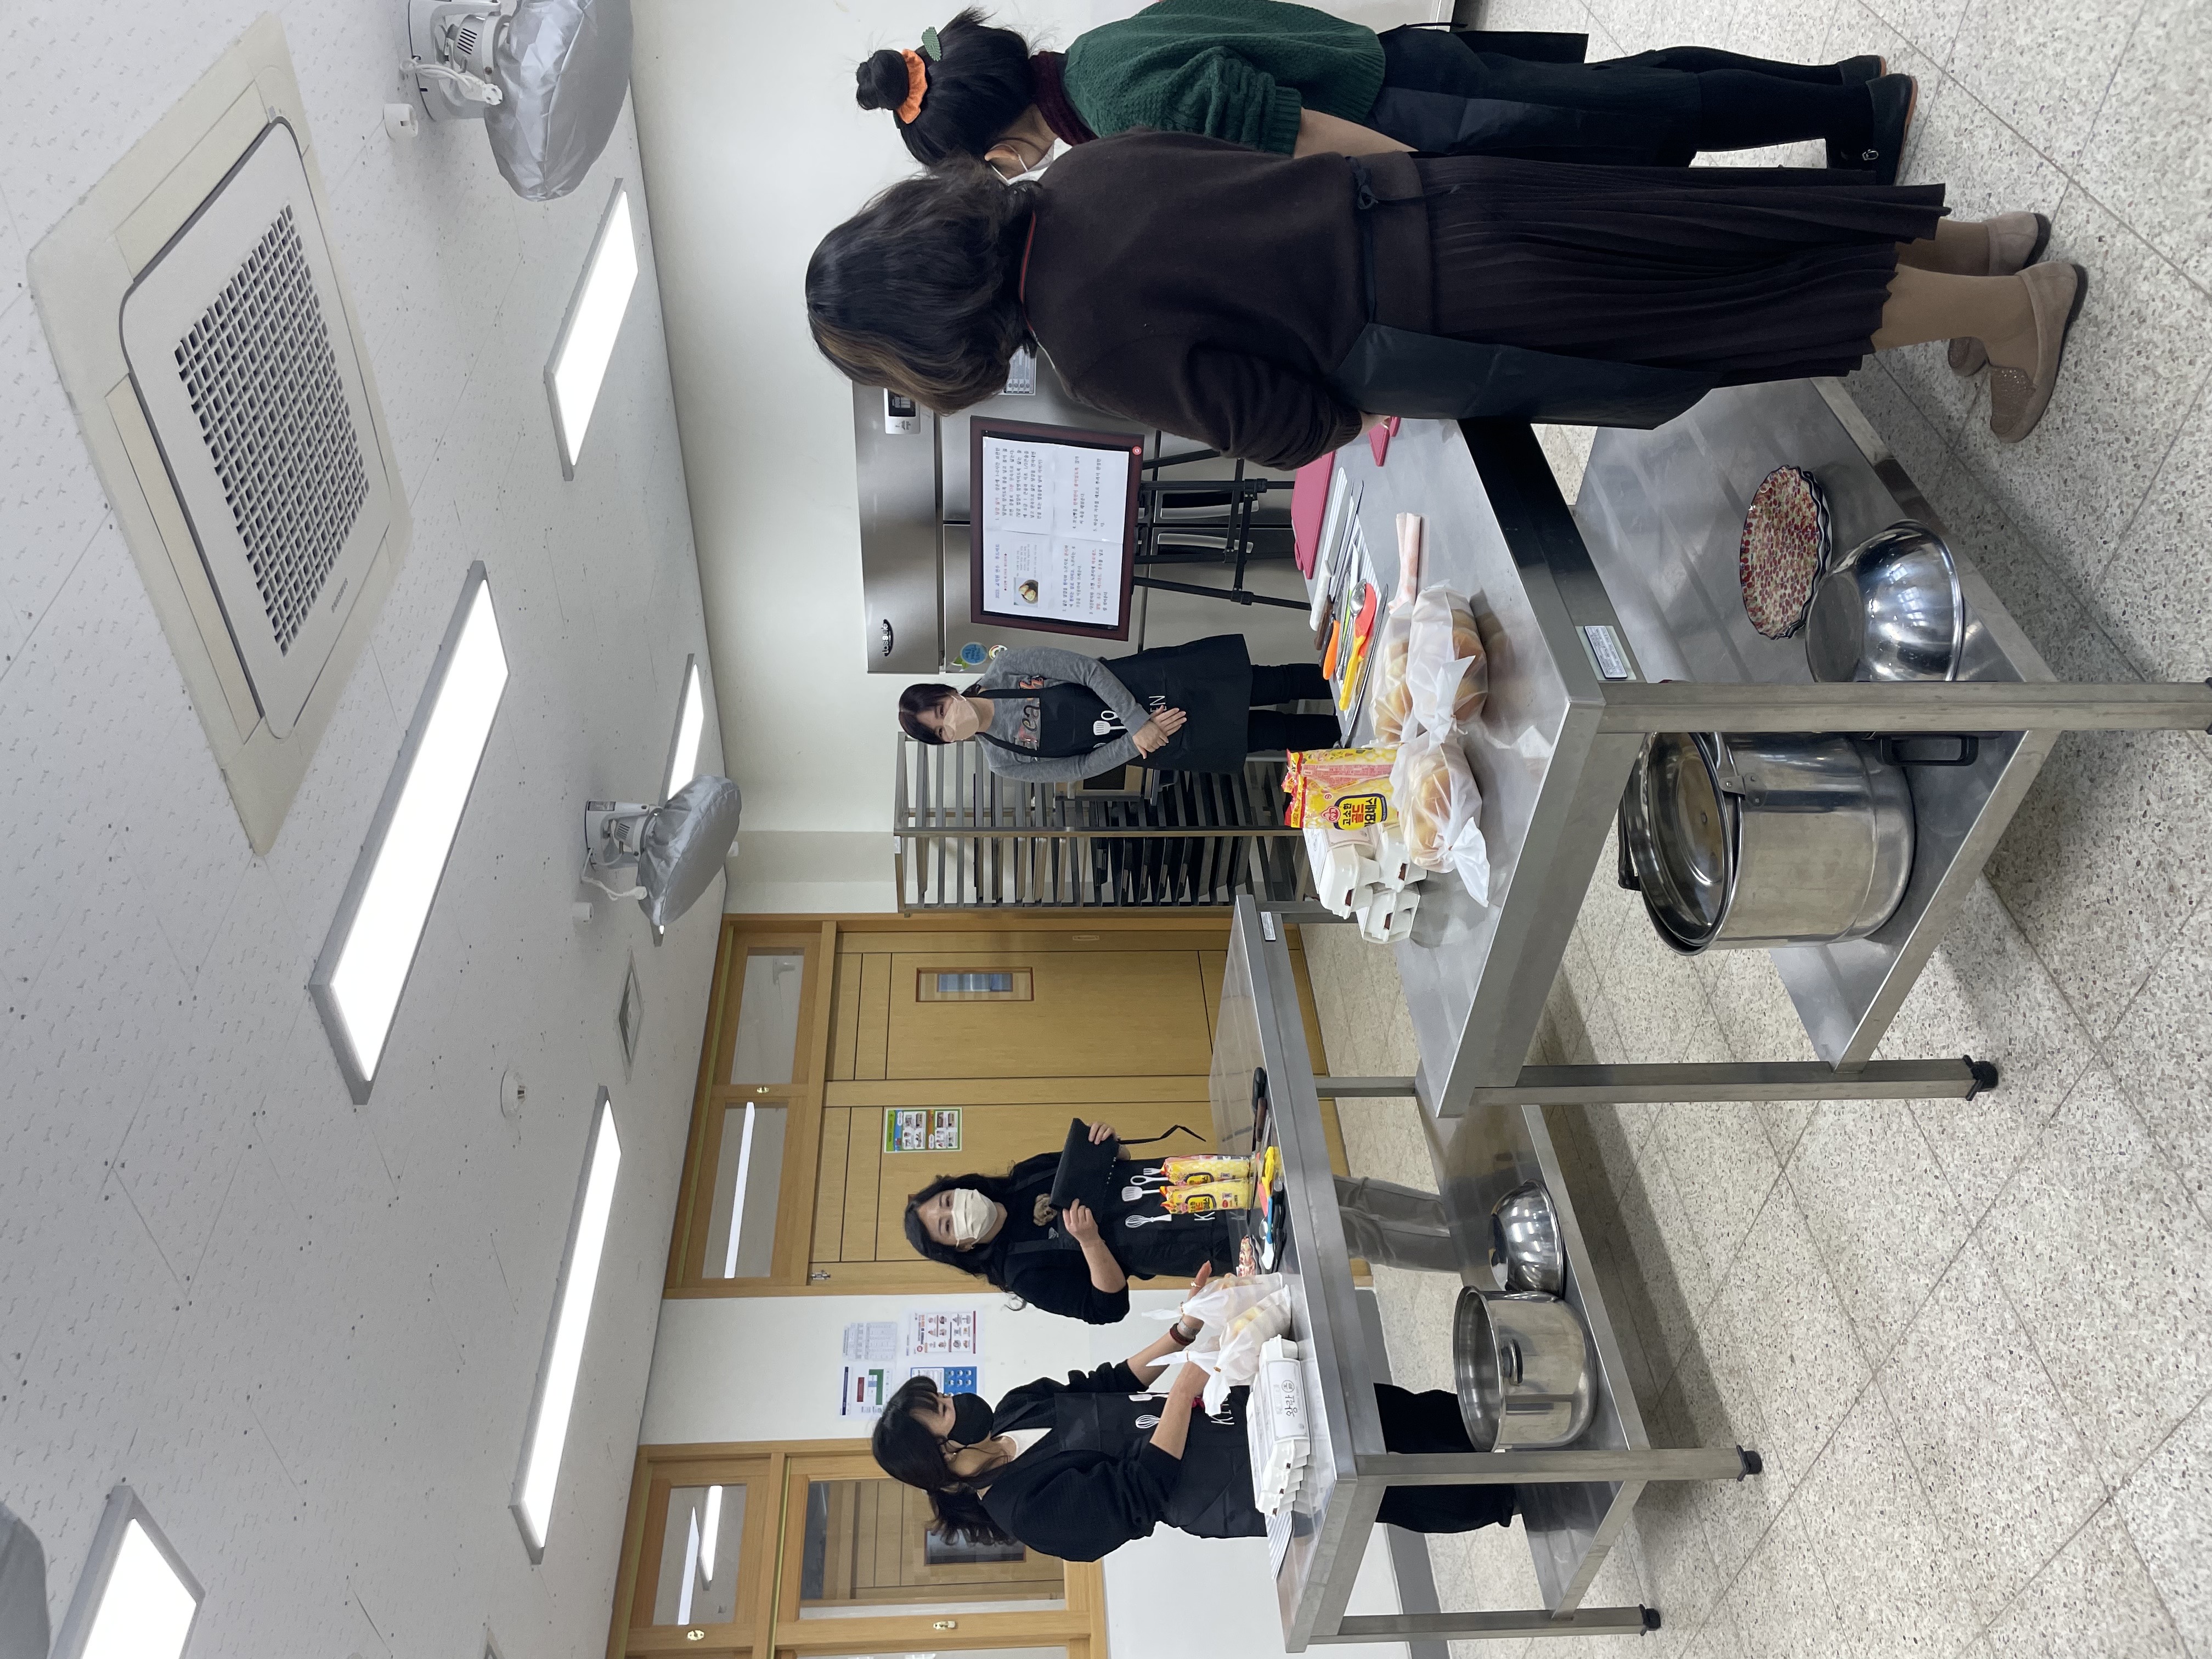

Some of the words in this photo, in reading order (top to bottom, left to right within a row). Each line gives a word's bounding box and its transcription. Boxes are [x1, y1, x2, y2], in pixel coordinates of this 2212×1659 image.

[1343, 803, 1352, 826] 고소한
[1352, 804, 1364, 823] 골드
[1285, 1395, 1298, 1418] 왕란
